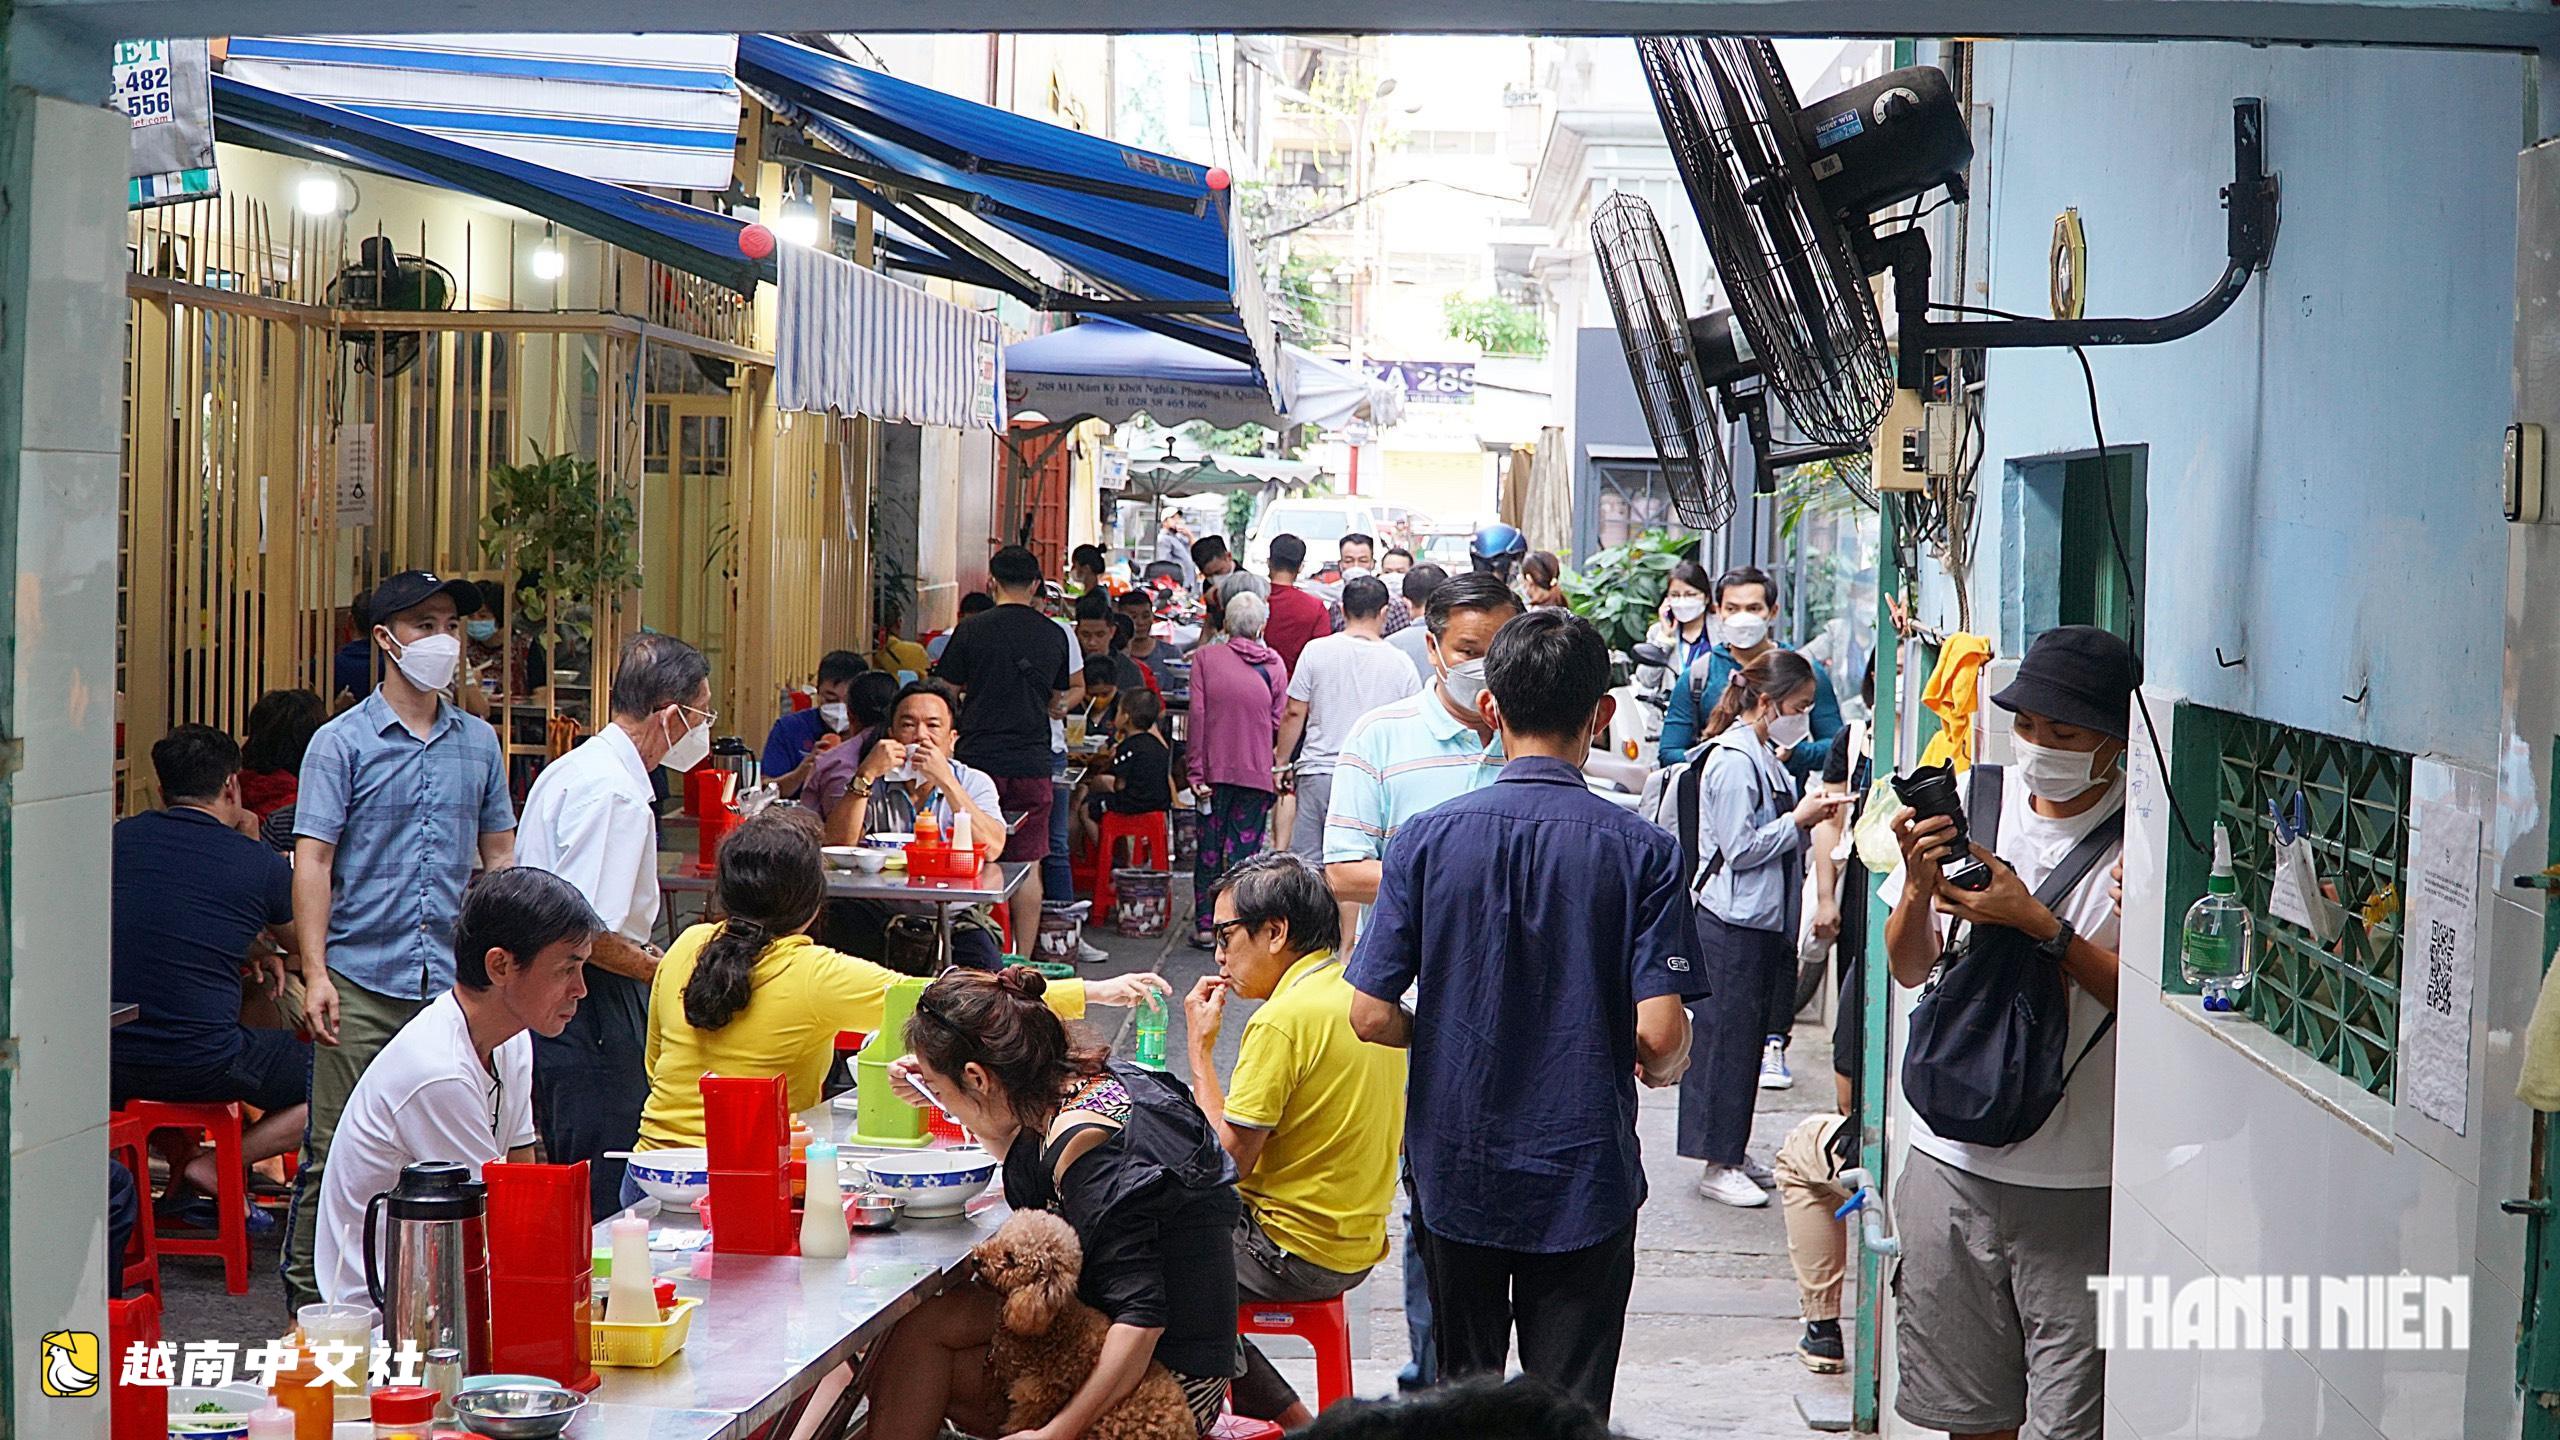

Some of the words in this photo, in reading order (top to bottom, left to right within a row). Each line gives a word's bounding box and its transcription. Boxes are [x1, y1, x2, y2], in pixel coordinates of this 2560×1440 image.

[112, 39, 164, 70] ẸT
[128, 92, 170, 117] 556
[1815, 117, 1837, 133] Super
[1838, 113, 1854, 124] win
